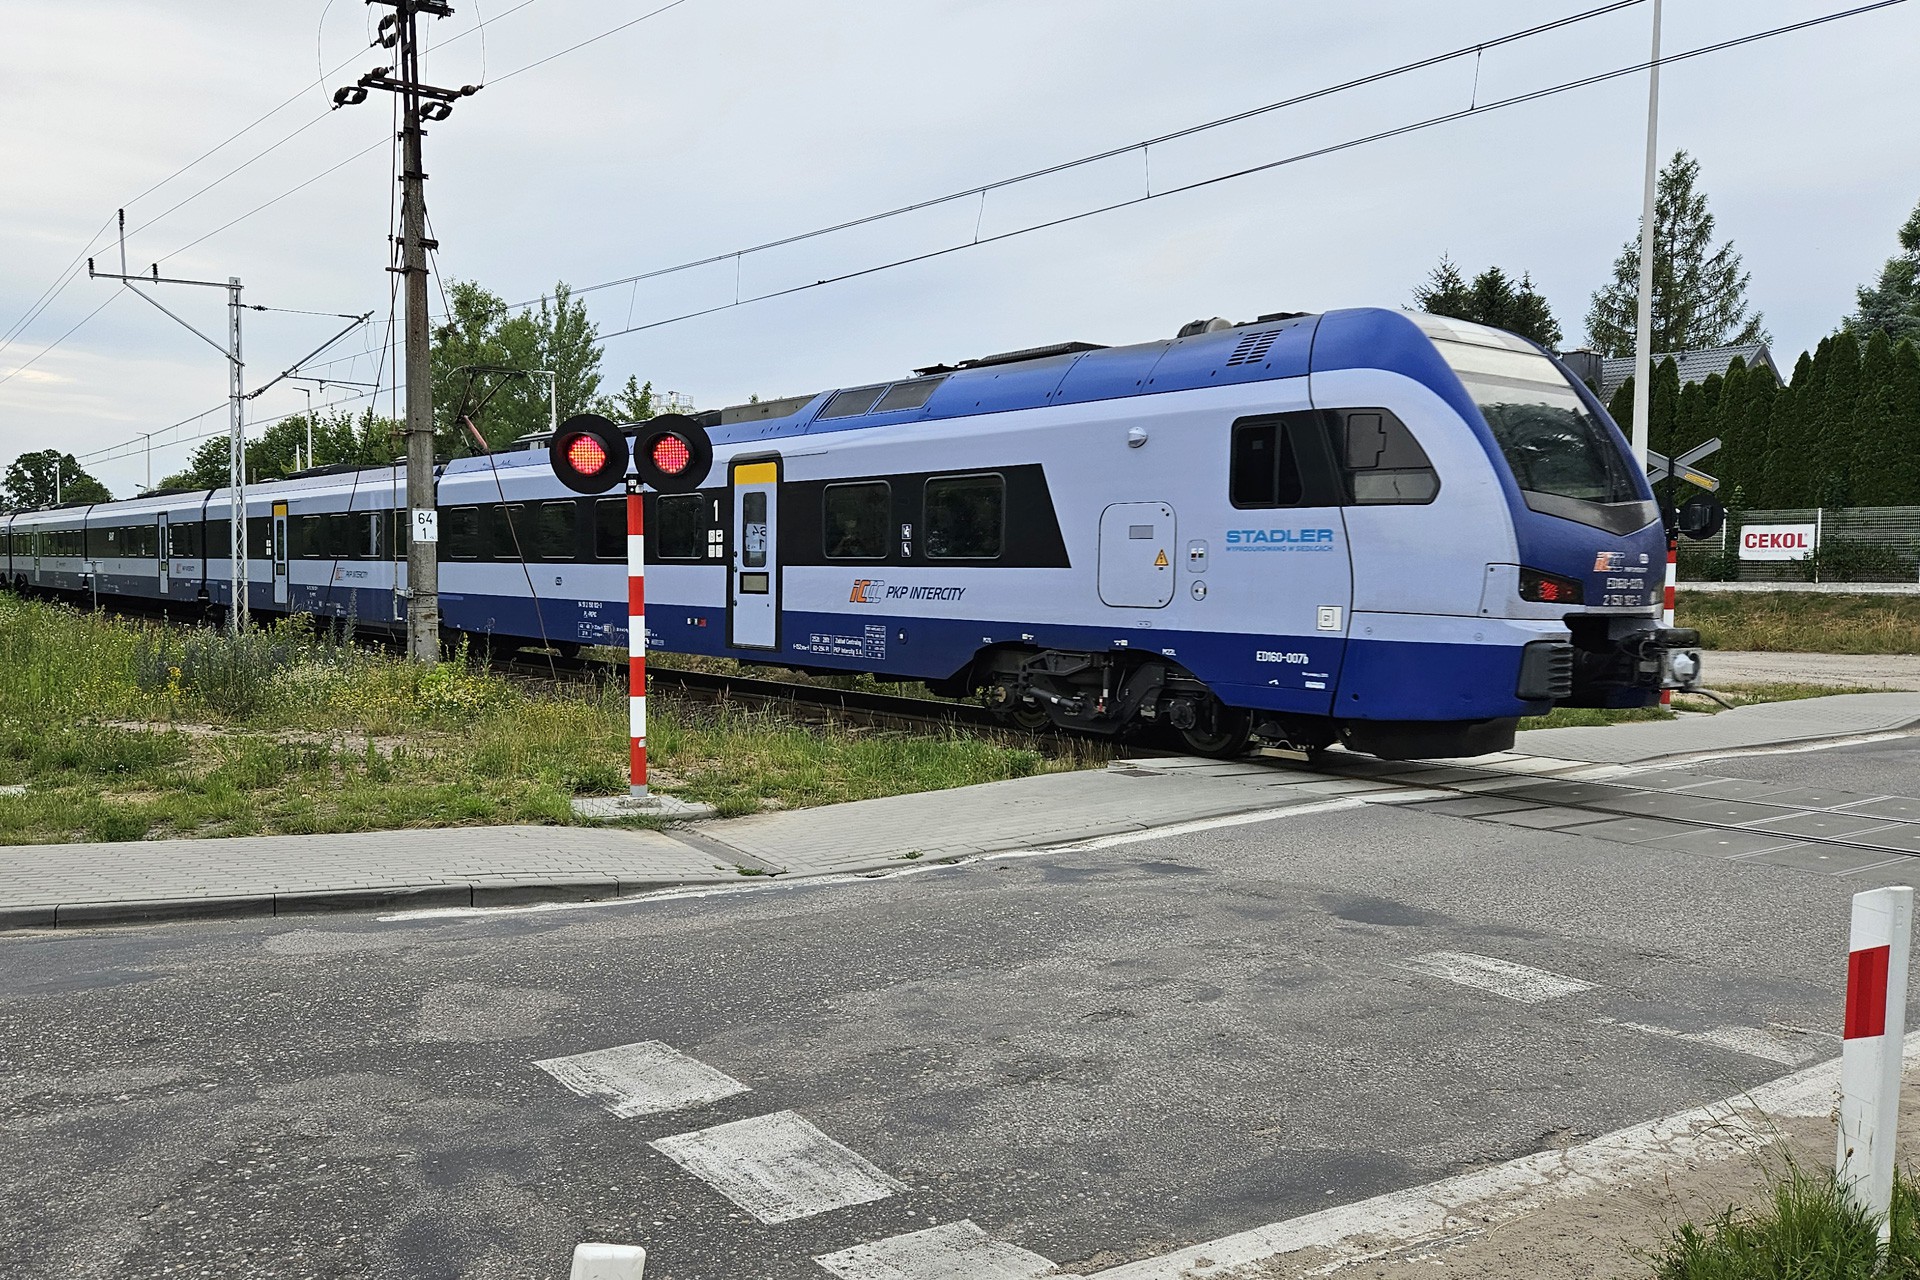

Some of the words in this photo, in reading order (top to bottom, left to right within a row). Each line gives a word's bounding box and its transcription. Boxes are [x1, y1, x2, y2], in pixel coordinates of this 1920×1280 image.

[713, 499, 719, 522] 1
[418, 512, 433, 525] 64
[422, 527, 427, 540] 1
[1226, 529, 1334, 543] STADLER
[1745, 533, 1808, 548] CEKOL
[885, 585, 908, 599] PKP
[909, 586, 967, 601] INTERCITY
